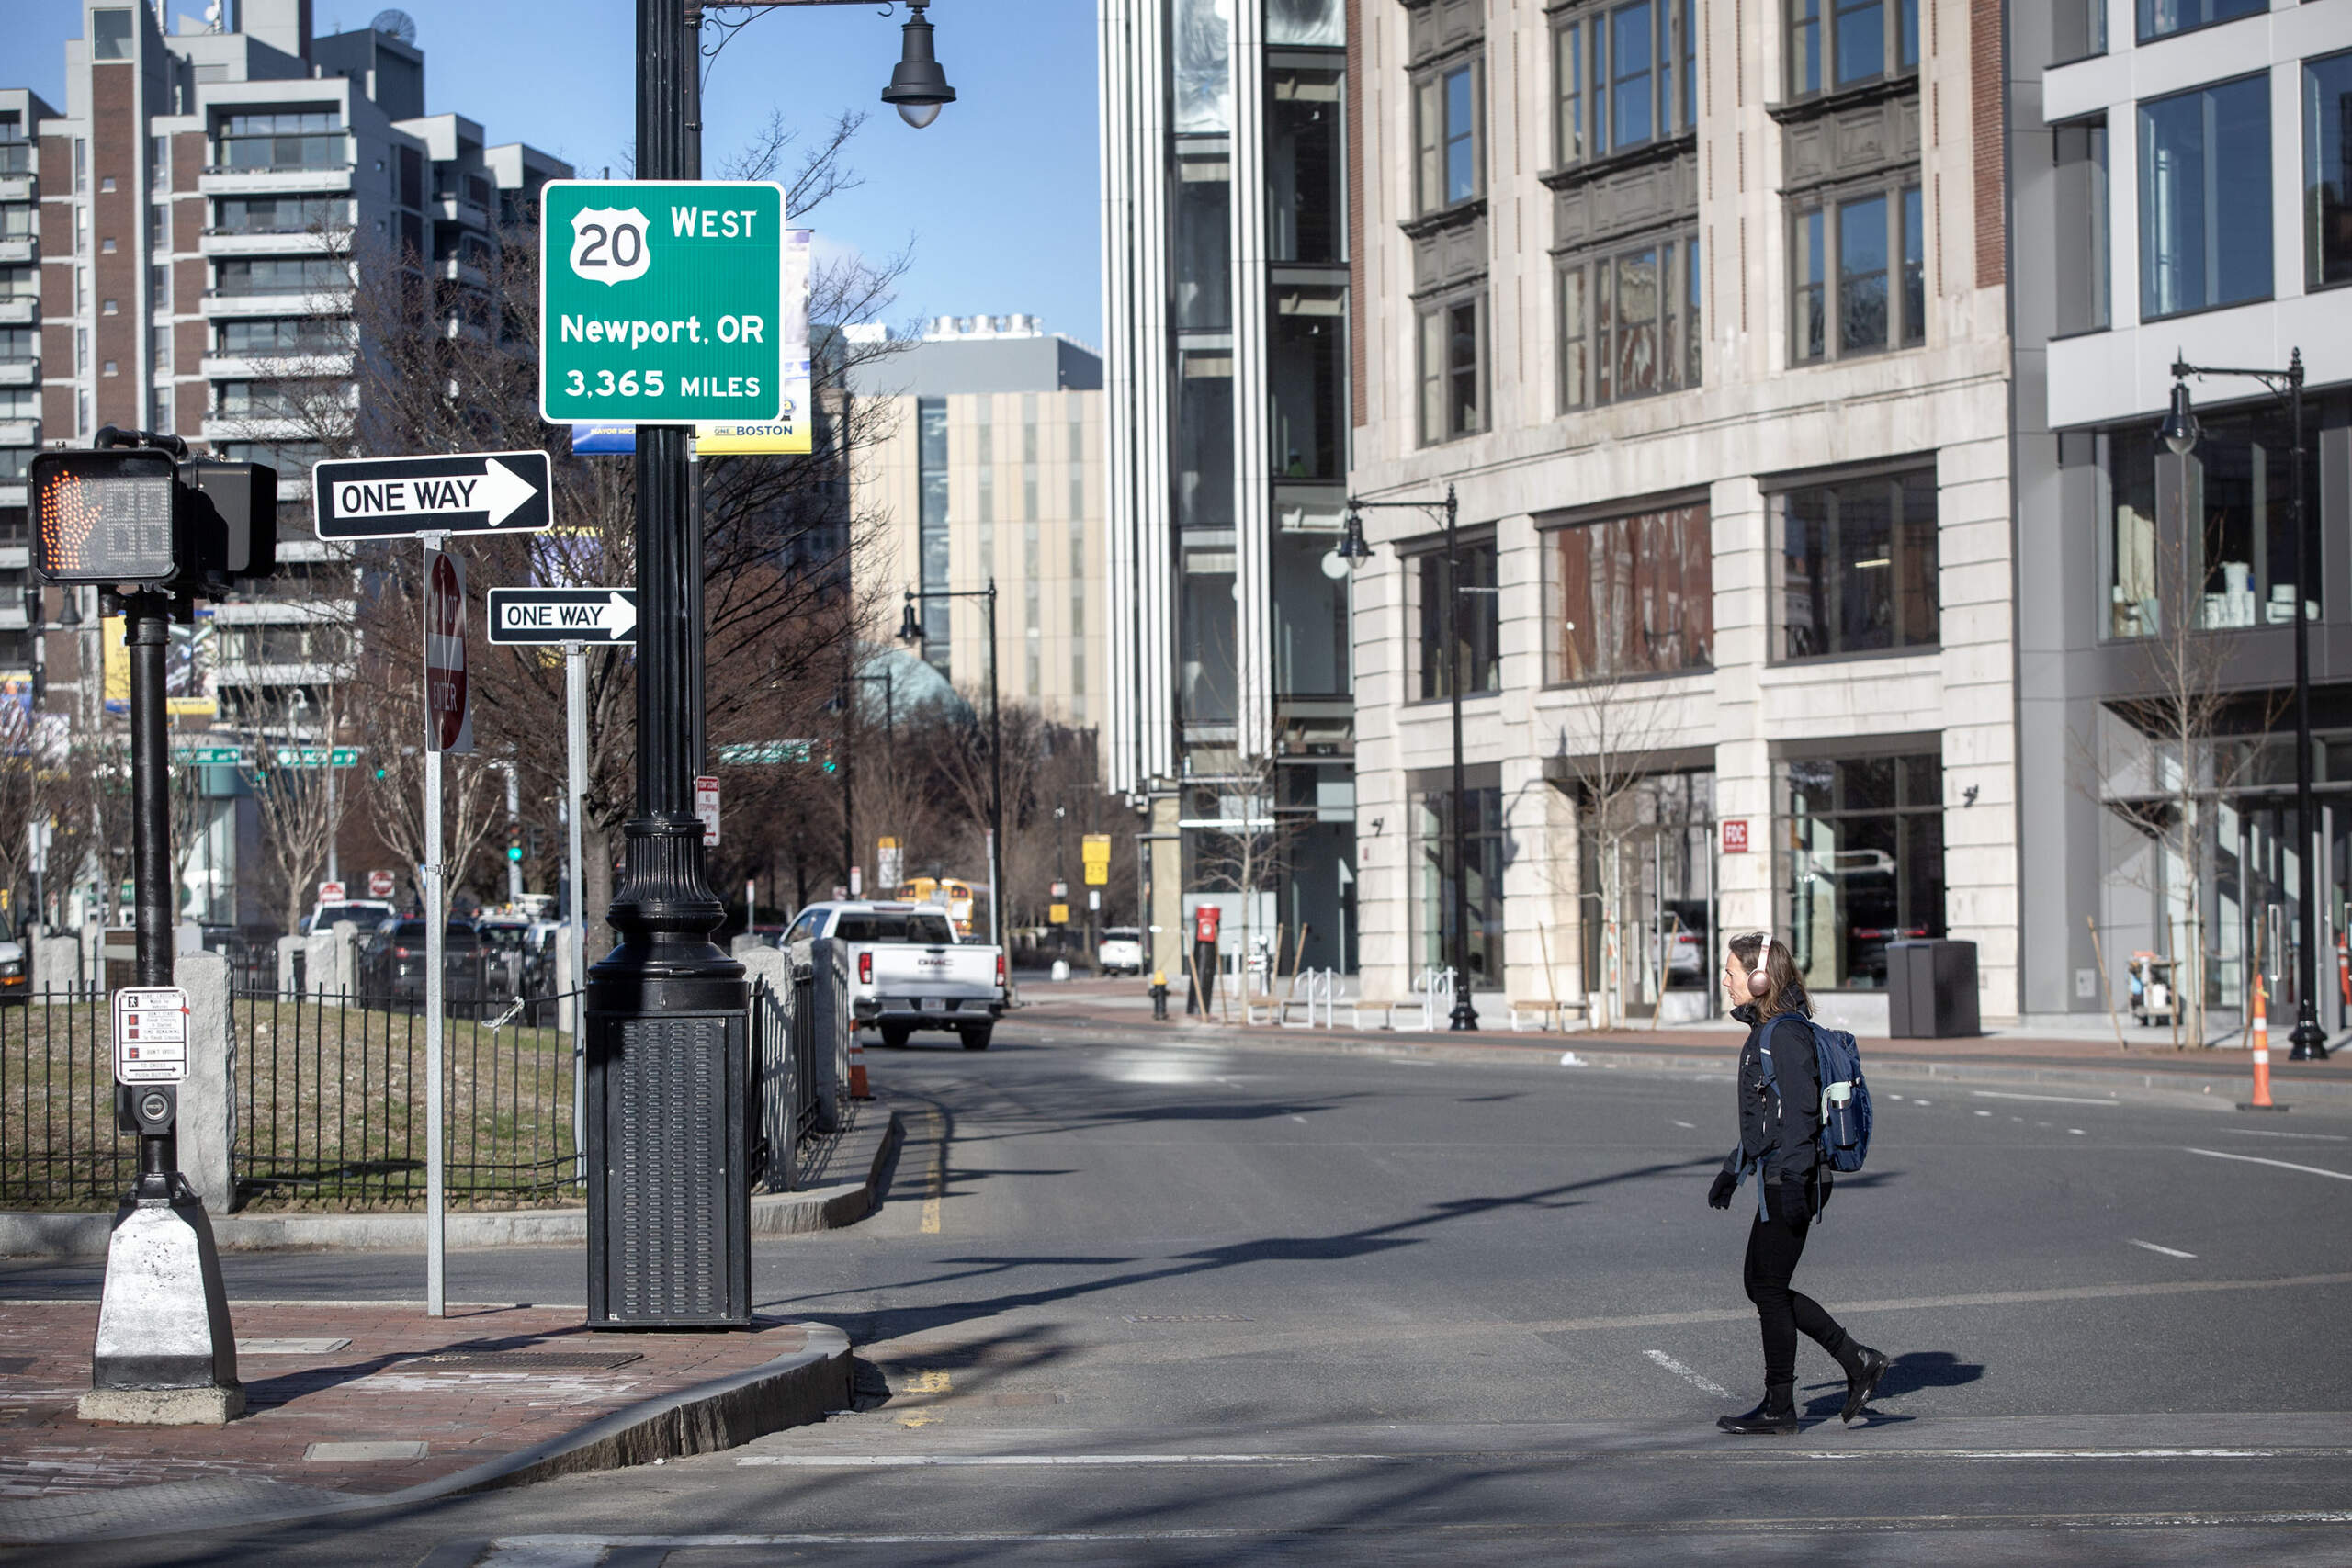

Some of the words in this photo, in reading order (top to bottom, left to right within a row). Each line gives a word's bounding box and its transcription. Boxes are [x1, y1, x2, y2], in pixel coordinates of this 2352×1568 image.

[671, 206, 757, 238] WEST
[579, 223, 641, 267] 20
[560, 314, 709, 350] Newport,
[717, 314, 764, 343] OR
[565, 369, 665, 399] 3,365
[681, 376, 761, 397] MILES
[737, 426, 793, 435] BOSTON
[342, 483, 406, 513] ONE
[413, 479, 478, 510] WAY
[444, 595, 458, 624] NOT
[507, 606, 552, 626] ONE
[559, 606, 605, 626] WAY
[434, 681, 458, 712] ENTER
